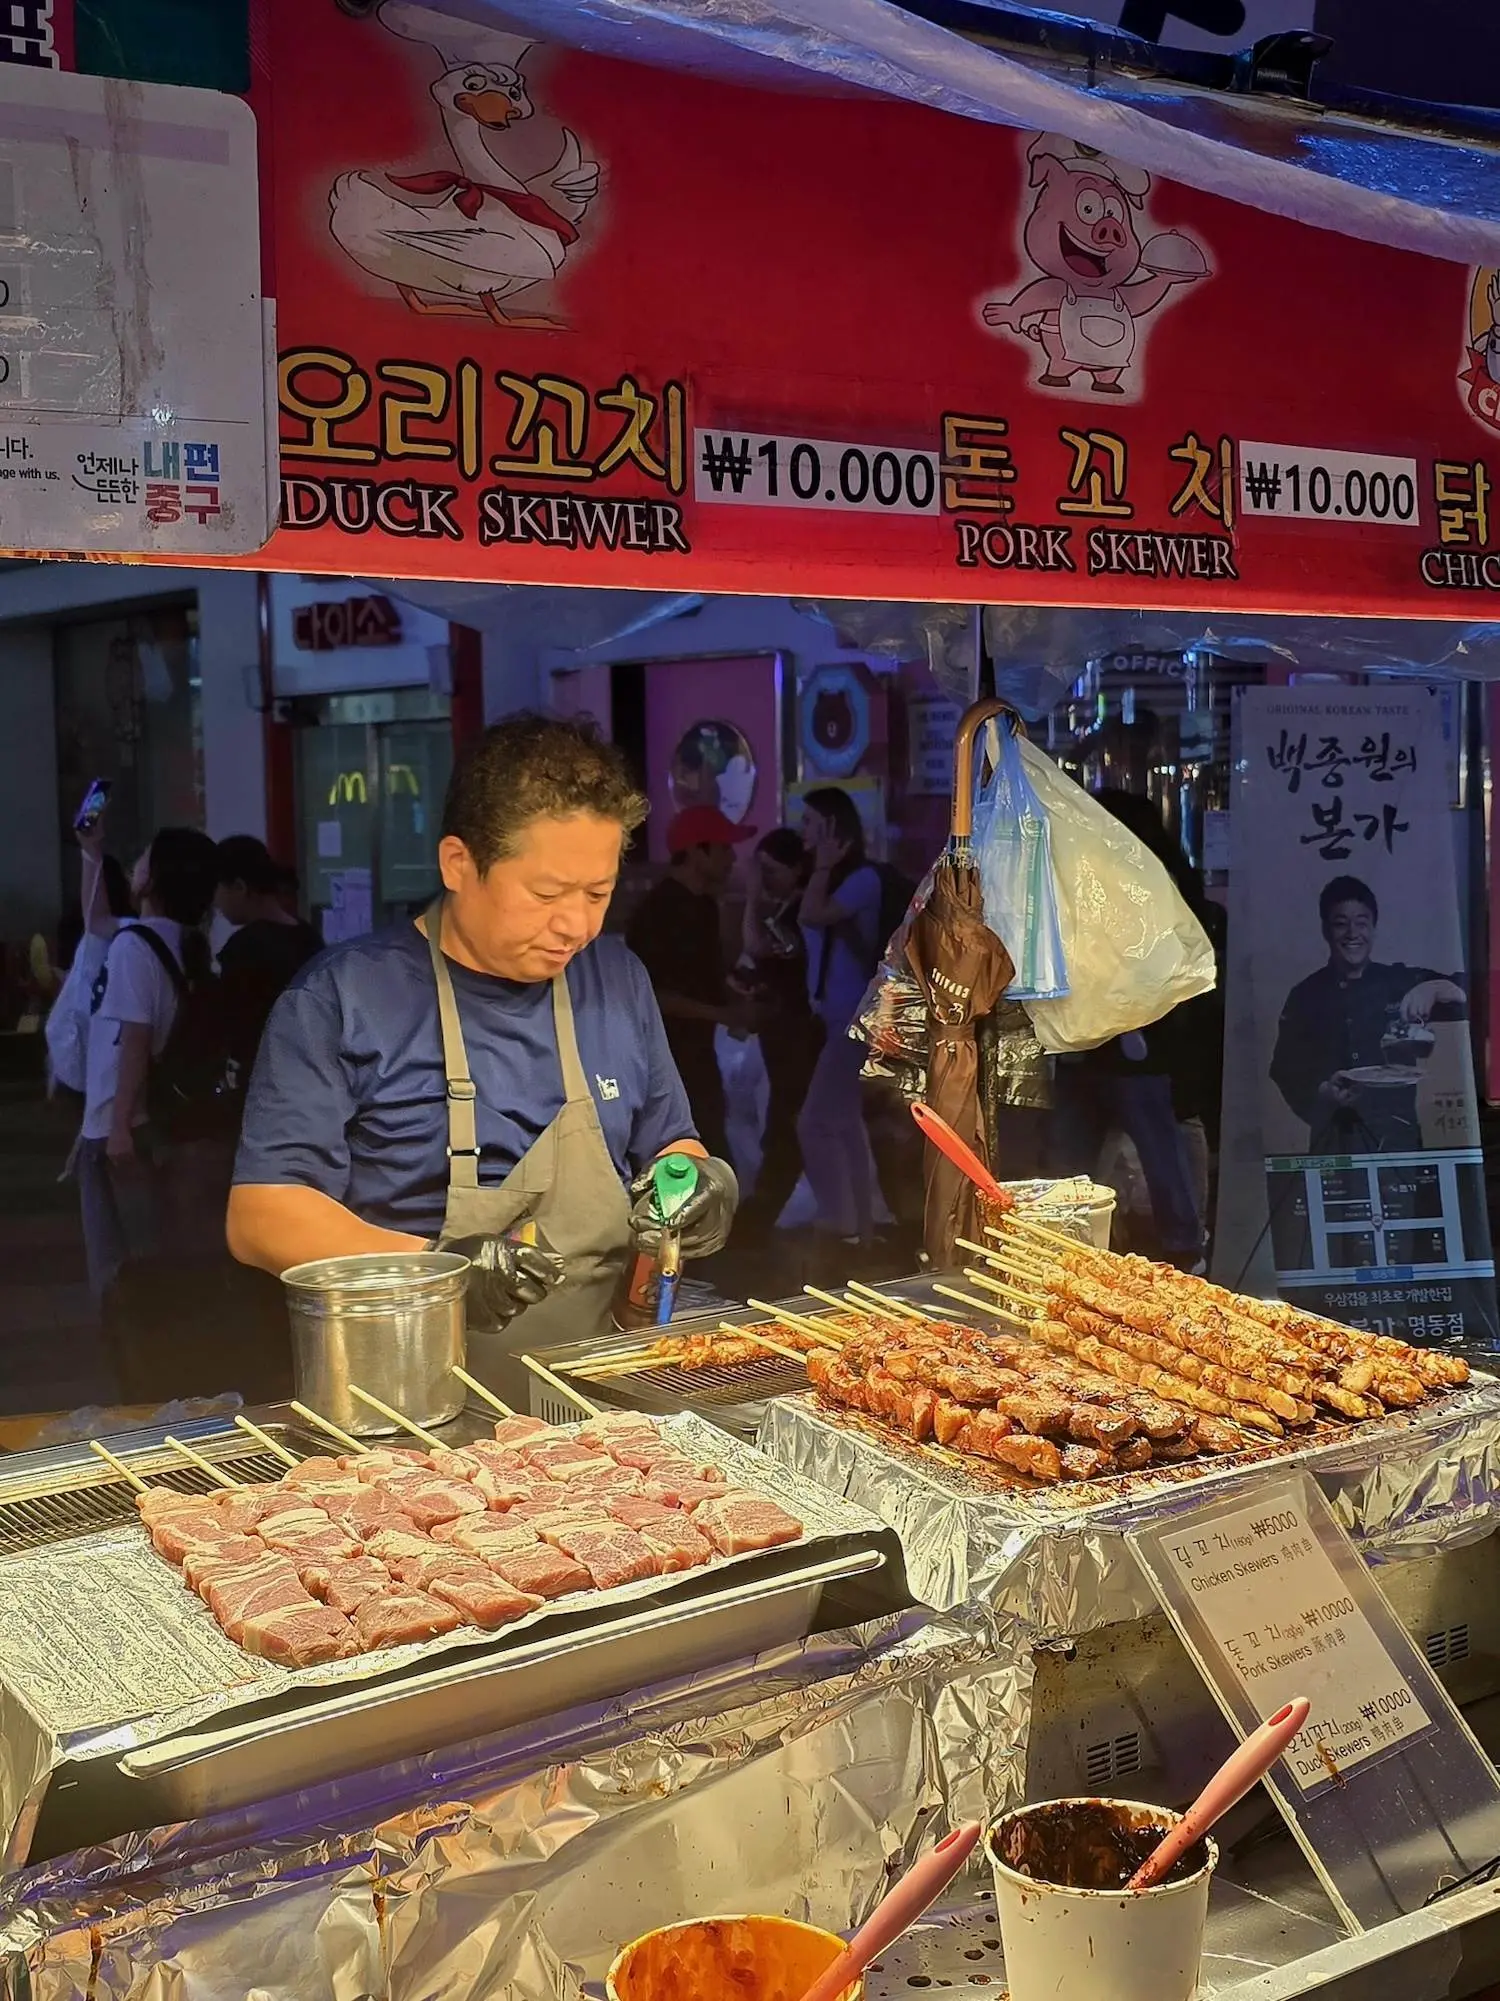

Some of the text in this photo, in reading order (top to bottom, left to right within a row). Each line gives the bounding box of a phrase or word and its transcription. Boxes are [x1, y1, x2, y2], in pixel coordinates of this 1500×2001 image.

[277, 350, 684, 492] 오리꼬치
[19, 467, 41, 479] with
[77, 452, 139, 476] 언제나
[143, 441, 220, 482] 내편
[702, 435, 935, 508] ₩10.000
[145, 483, 221, 525] 중구
[1246, 461, 1414, 520] ₩10.000
[281, 479, 688, 550] DUCK SKEWER
[957, 523, 1237, 578] PORK SKEWER
[291, 596, 403, 651] 다이소
[1113, 655, 1192, 683] OFFIC
[1267, 704, 1410, 716] ORIGINAL KOREAN TASTE
[1267, 729, 1417, 793] 백종원의
[1300, 796, 1409, 860] 본가
[1408, 1313, 1464, 1337] 명동점
[1250, 1511, 1298, 1539] ₩5000
[1191, 1553, 1279, 1592] Chicken Skewers
[1300, 1597, 1354, 1629] ₩10000
[1240, 1645, 1313, 1681] Pork Skewers
[1358, 1689, 1411, 1723] ₩10000
[1296, 1735, 1371, 1776] Duck Skewers
